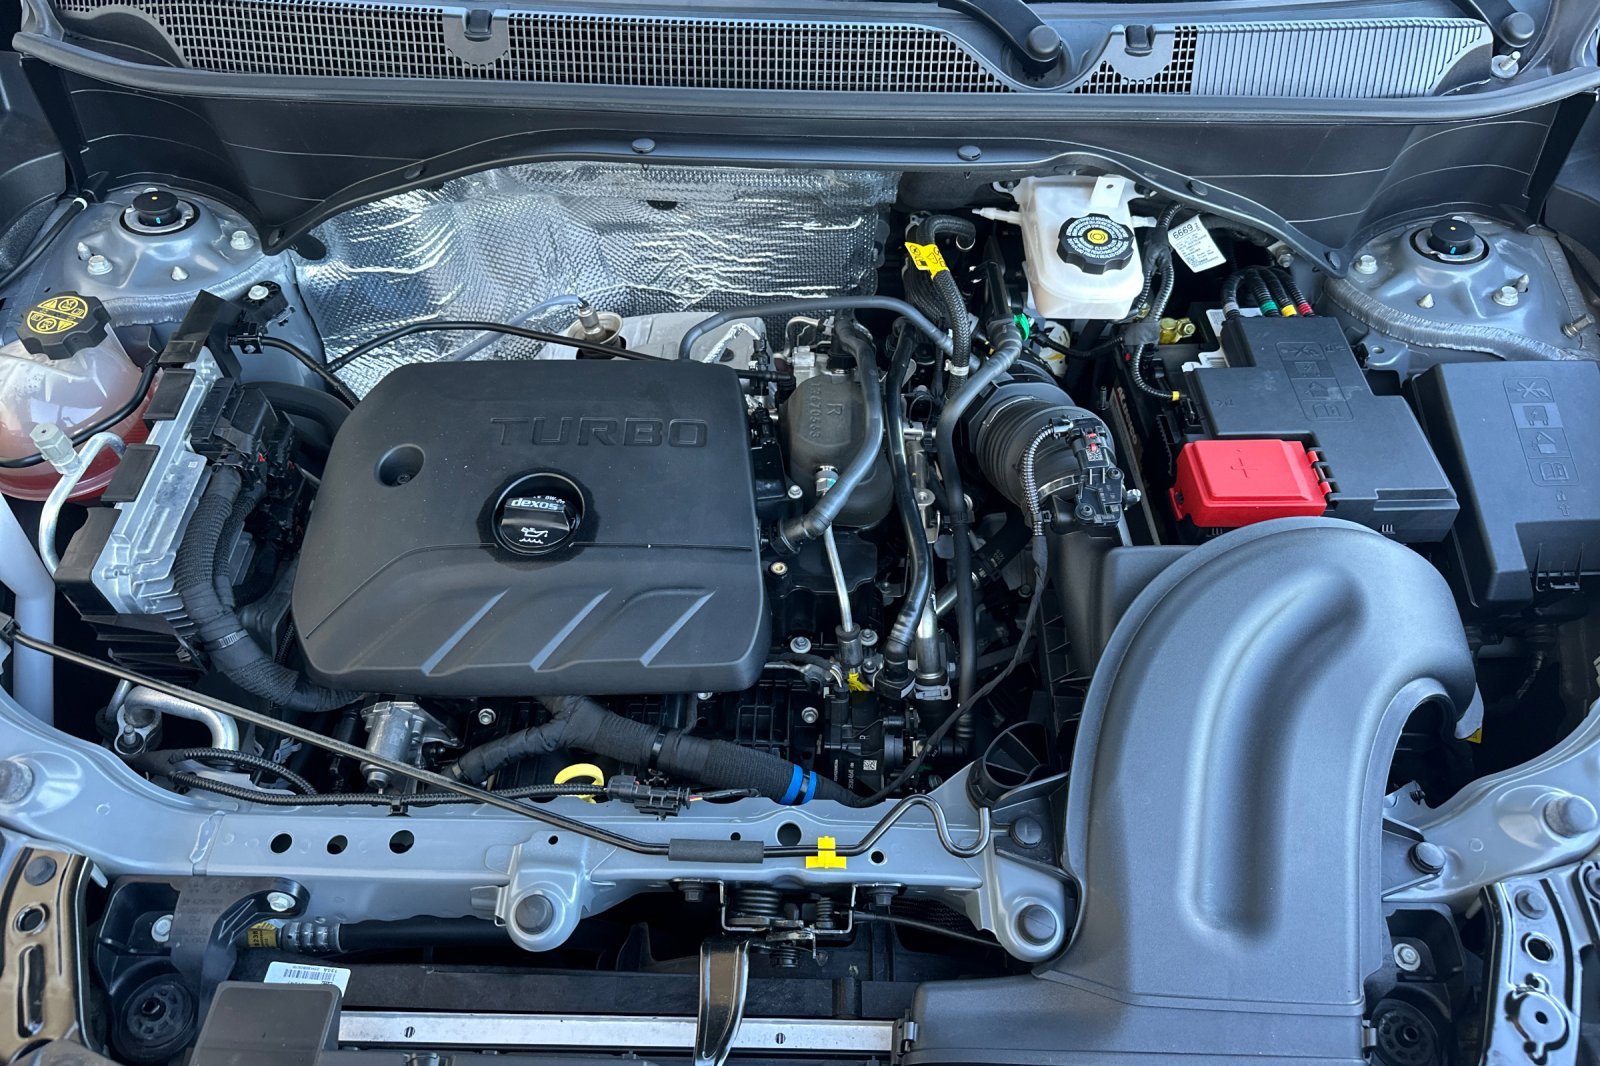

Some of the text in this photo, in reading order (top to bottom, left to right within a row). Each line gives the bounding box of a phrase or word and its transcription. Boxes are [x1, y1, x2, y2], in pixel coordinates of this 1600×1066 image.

[1172, 223, 1194, 240] 6669
[490, 416, 708, 448] TURBO
[511, 498, 560, 511] dexos
